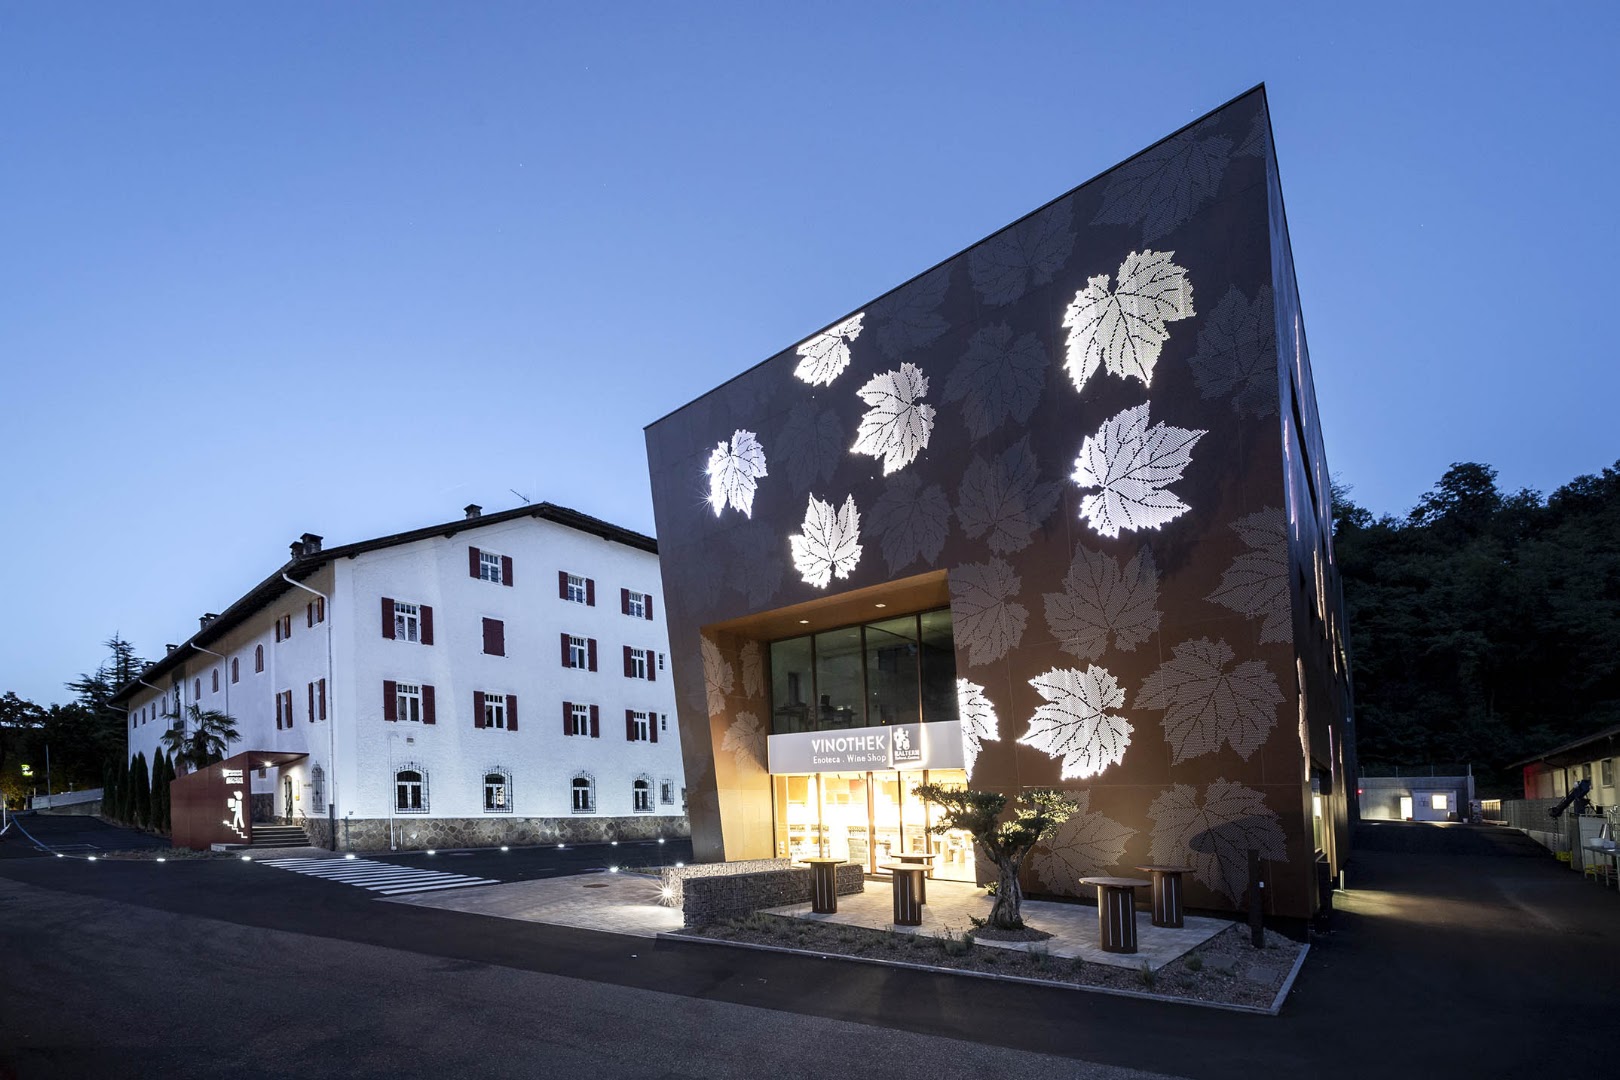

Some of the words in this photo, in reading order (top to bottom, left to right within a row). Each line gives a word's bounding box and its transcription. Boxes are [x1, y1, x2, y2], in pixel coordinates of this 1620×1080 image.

[811, 735, 885, 753] VINOTHEK
[813, 756, 840, 764] Enoteca
[846, 754, 866, 763] Wine
[867, 753, 887, 764] Shop
